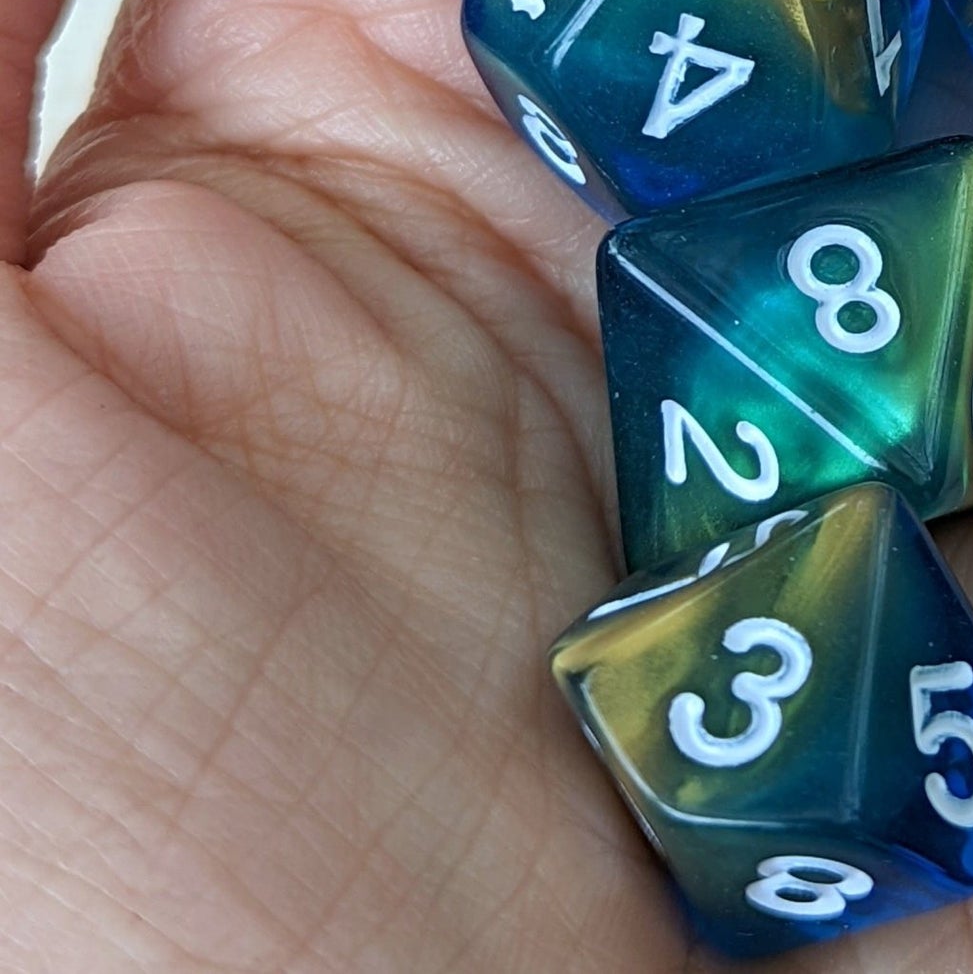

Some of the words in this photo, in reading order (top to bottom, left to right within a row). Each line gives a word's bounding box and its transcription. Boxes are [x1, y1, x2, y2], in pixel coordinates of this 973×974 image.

[648, 12, 756, 138] 4
[787, 224, 900, 353] 8
[660, 400, 780, 502] 2
[668, 617, 813, 768] 3
[745, 855, 874, 920] 8
